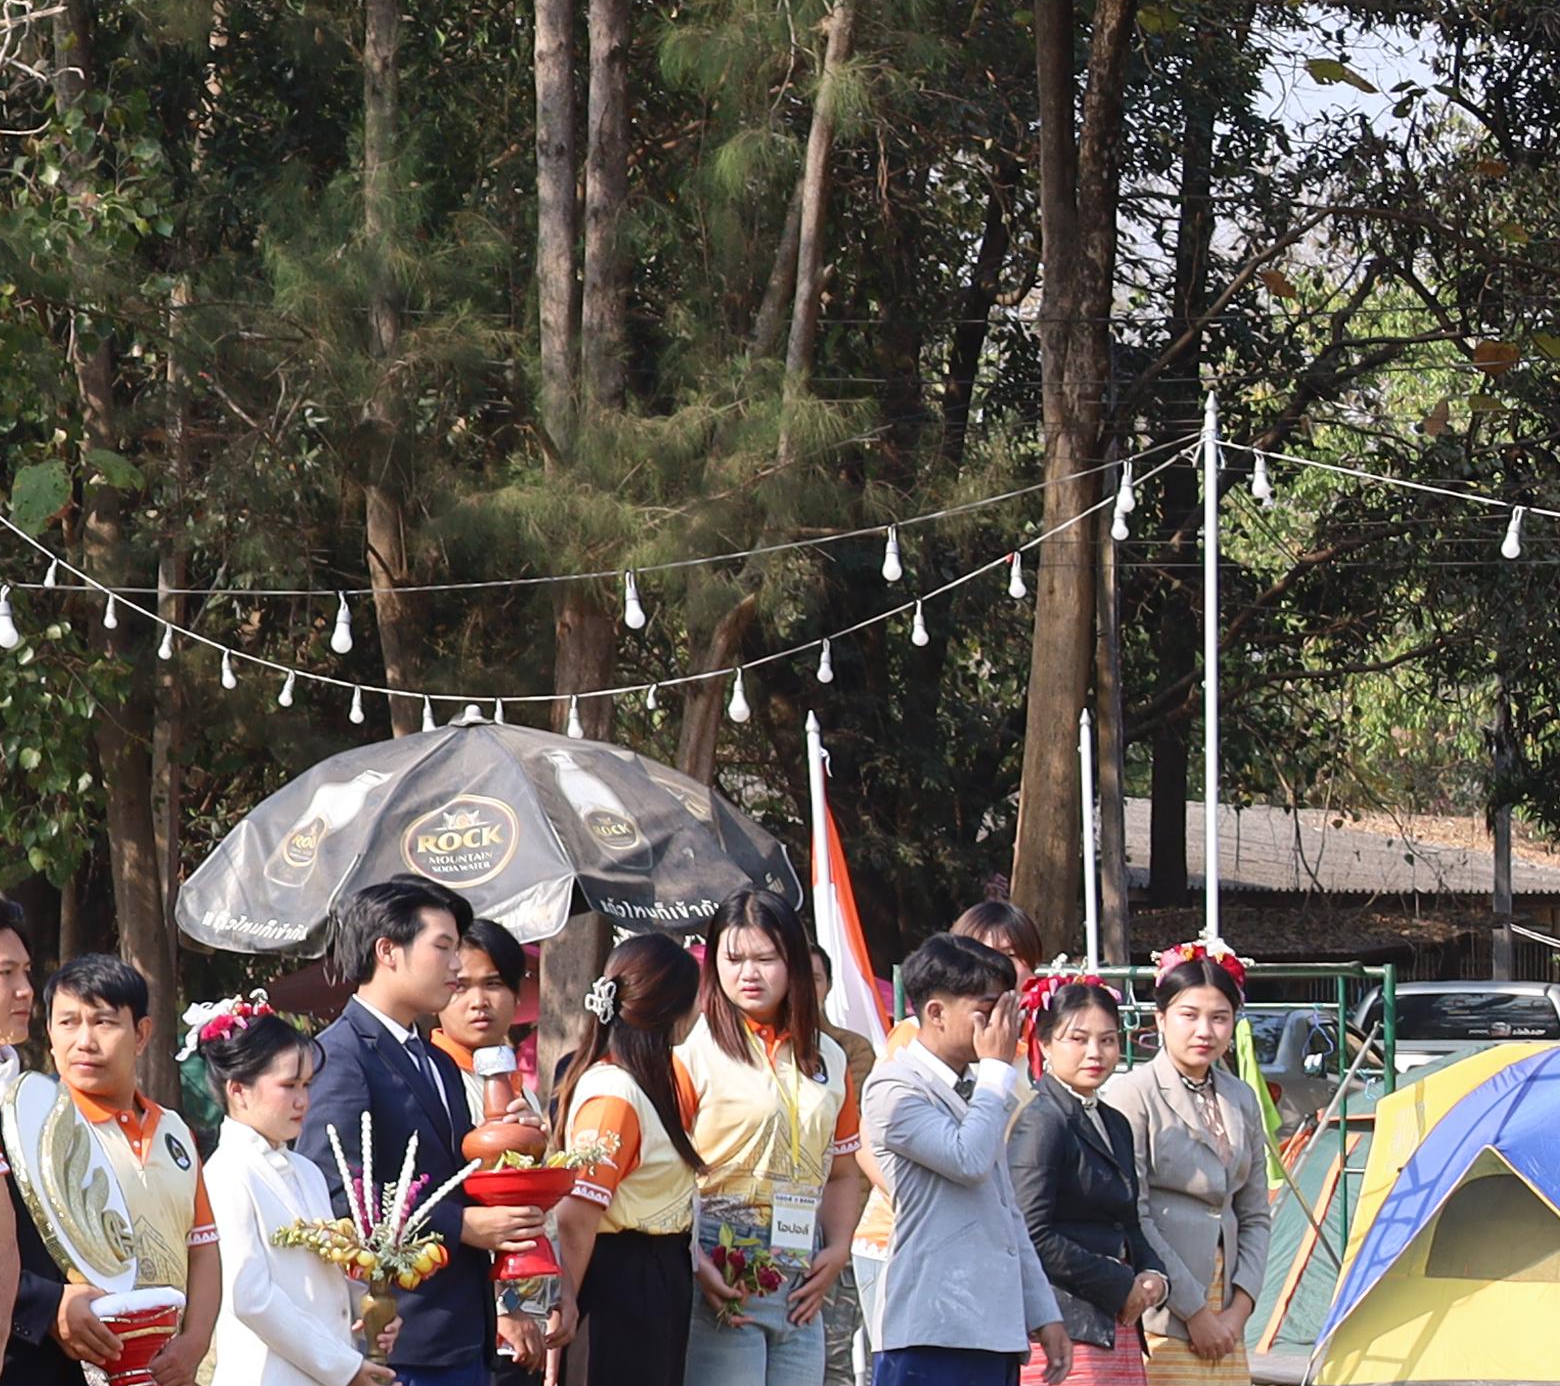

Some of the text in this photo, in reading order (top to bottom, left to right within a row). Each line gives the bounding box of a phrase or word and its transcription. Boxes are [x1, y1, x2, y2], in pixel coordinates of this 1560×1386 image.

[593, 822, 632, 836] ROCK
[417, 824, 504, 855] ROCK
[429, 851, 494, 865] MOUNTAIN
